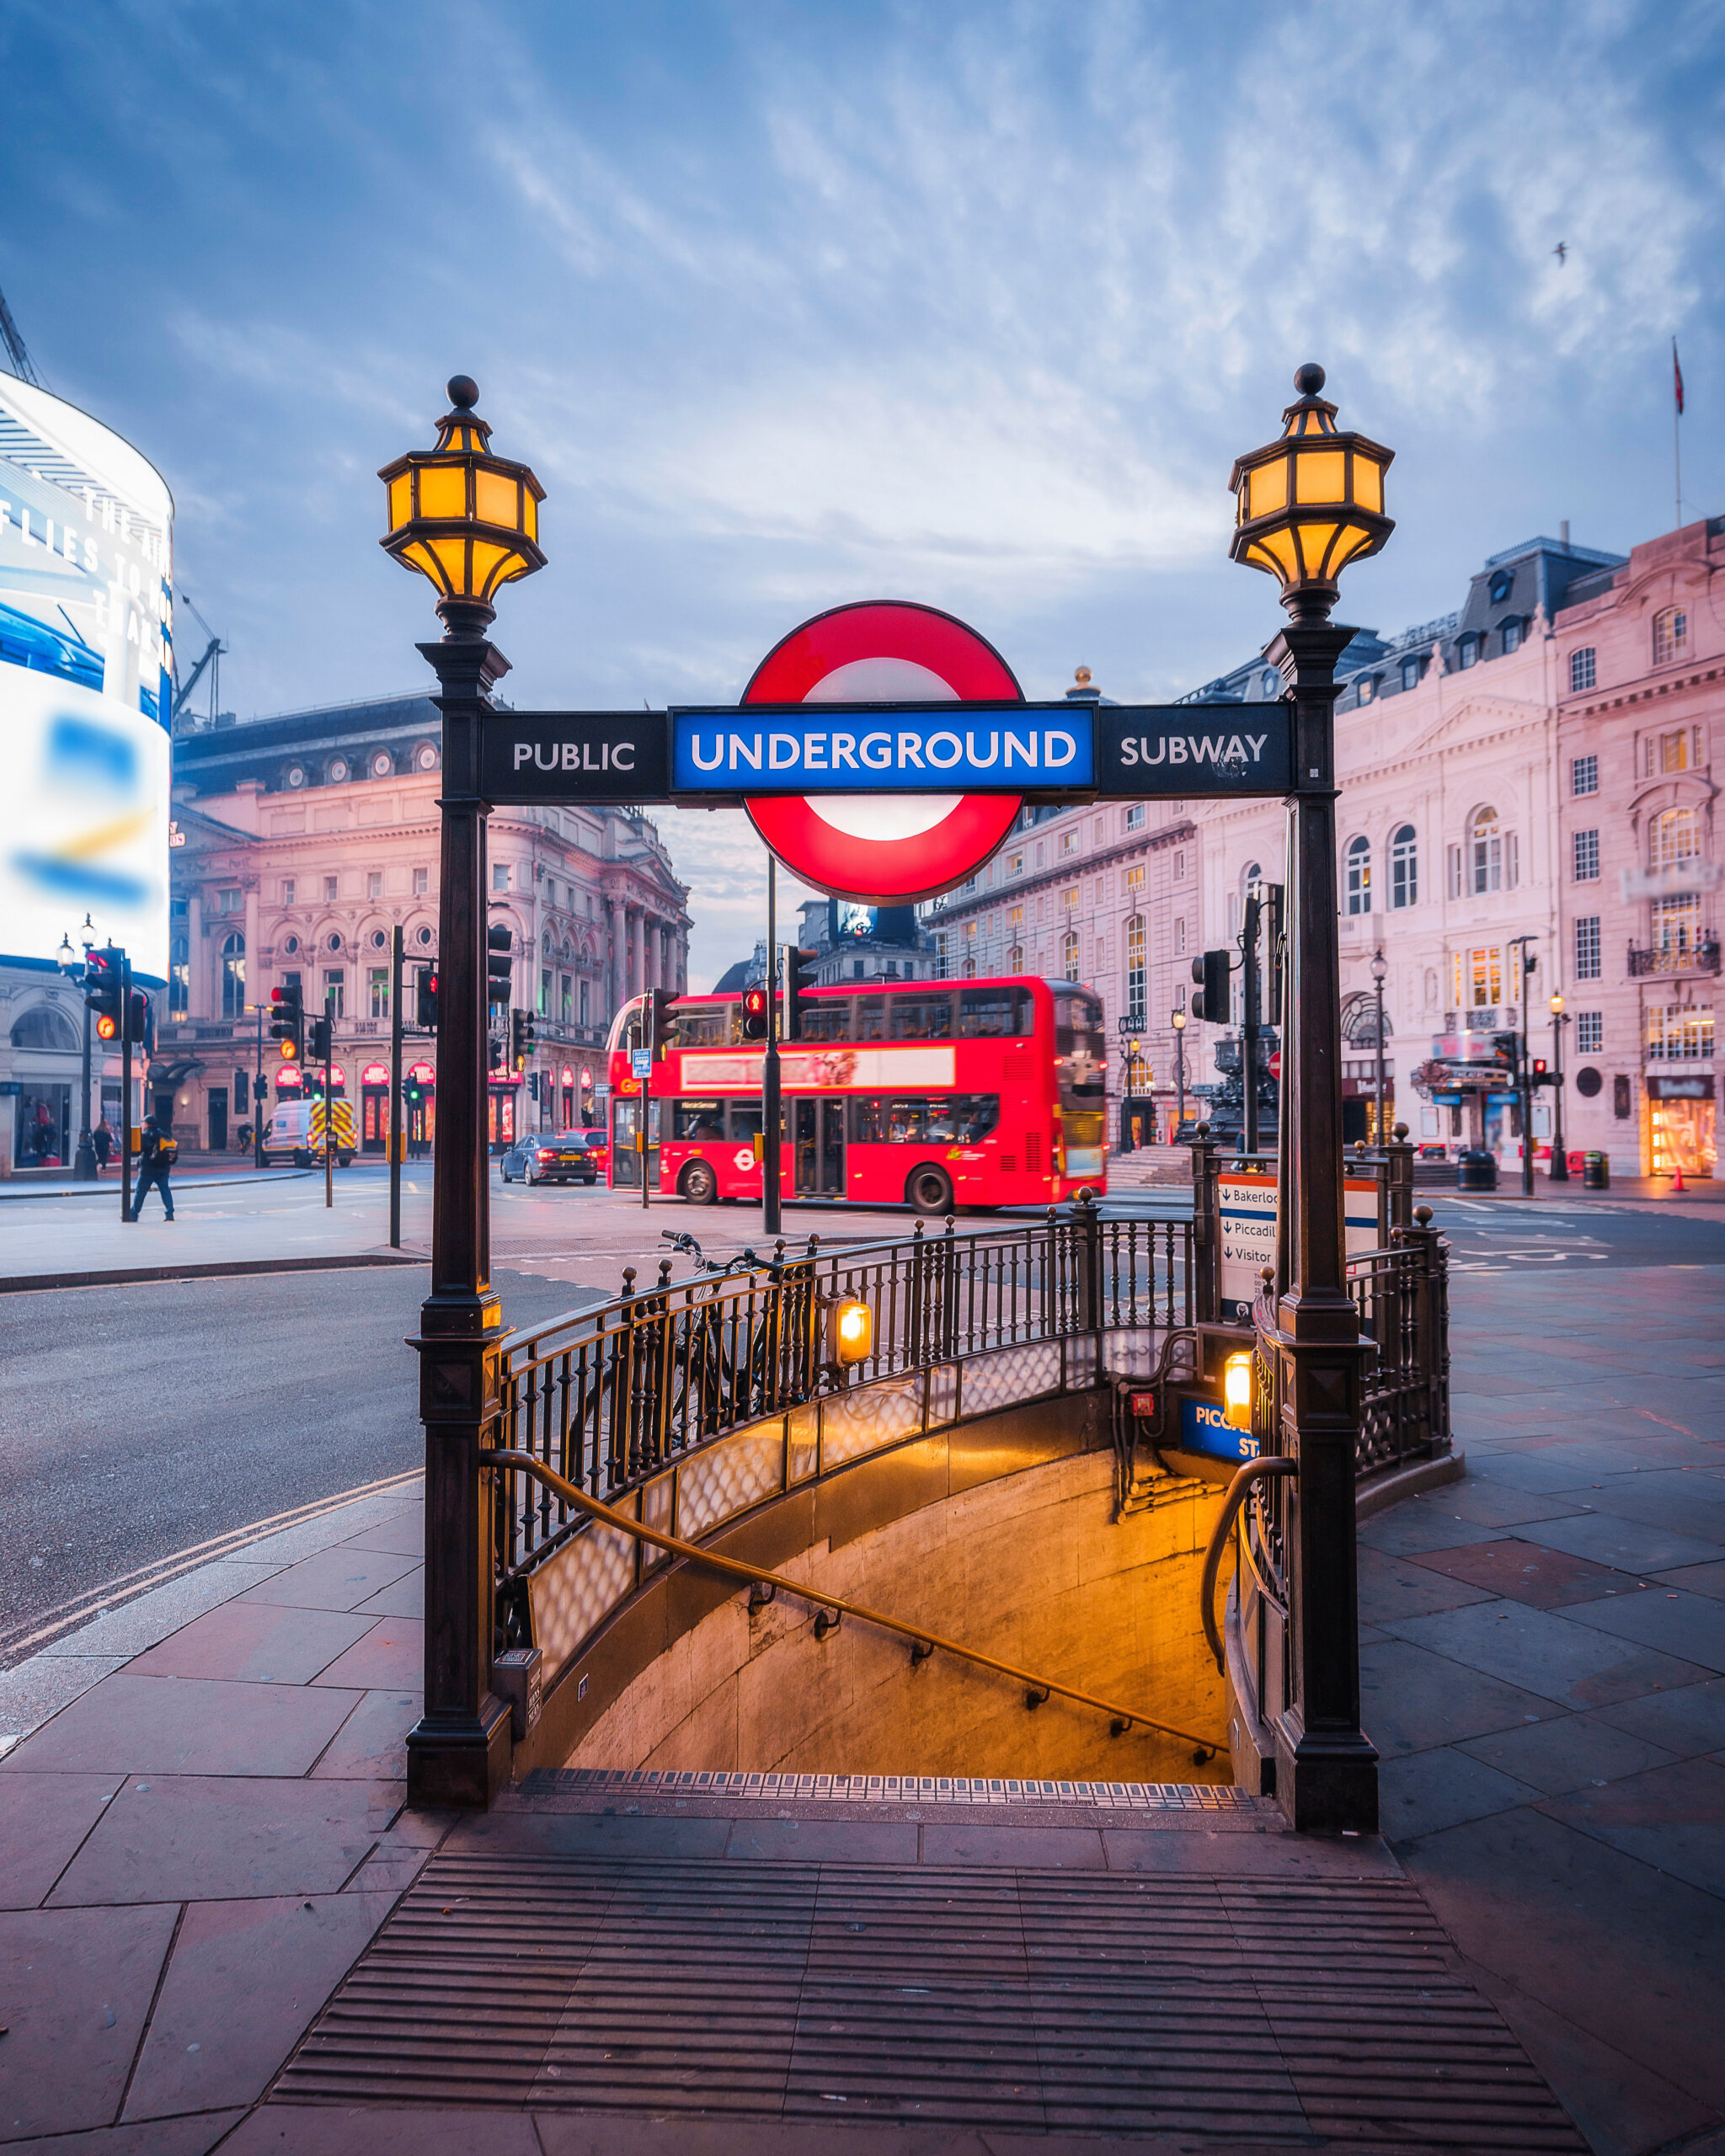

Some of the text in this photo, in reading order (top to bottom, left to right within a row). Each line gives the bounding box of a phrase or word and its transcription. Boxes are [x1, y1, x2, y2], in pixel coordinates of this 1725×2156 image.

[83, 485, 131, 545] THE
[514, 743, 635, 771] PUBLIC
[692, 730, 1076, 771] UNDERGROUND
[1120, 734, 1268, 766] SUBWAY
[1236, 1247, 1271, 1262] Visitor
[1238, 1438, 1259, 1457] ST
